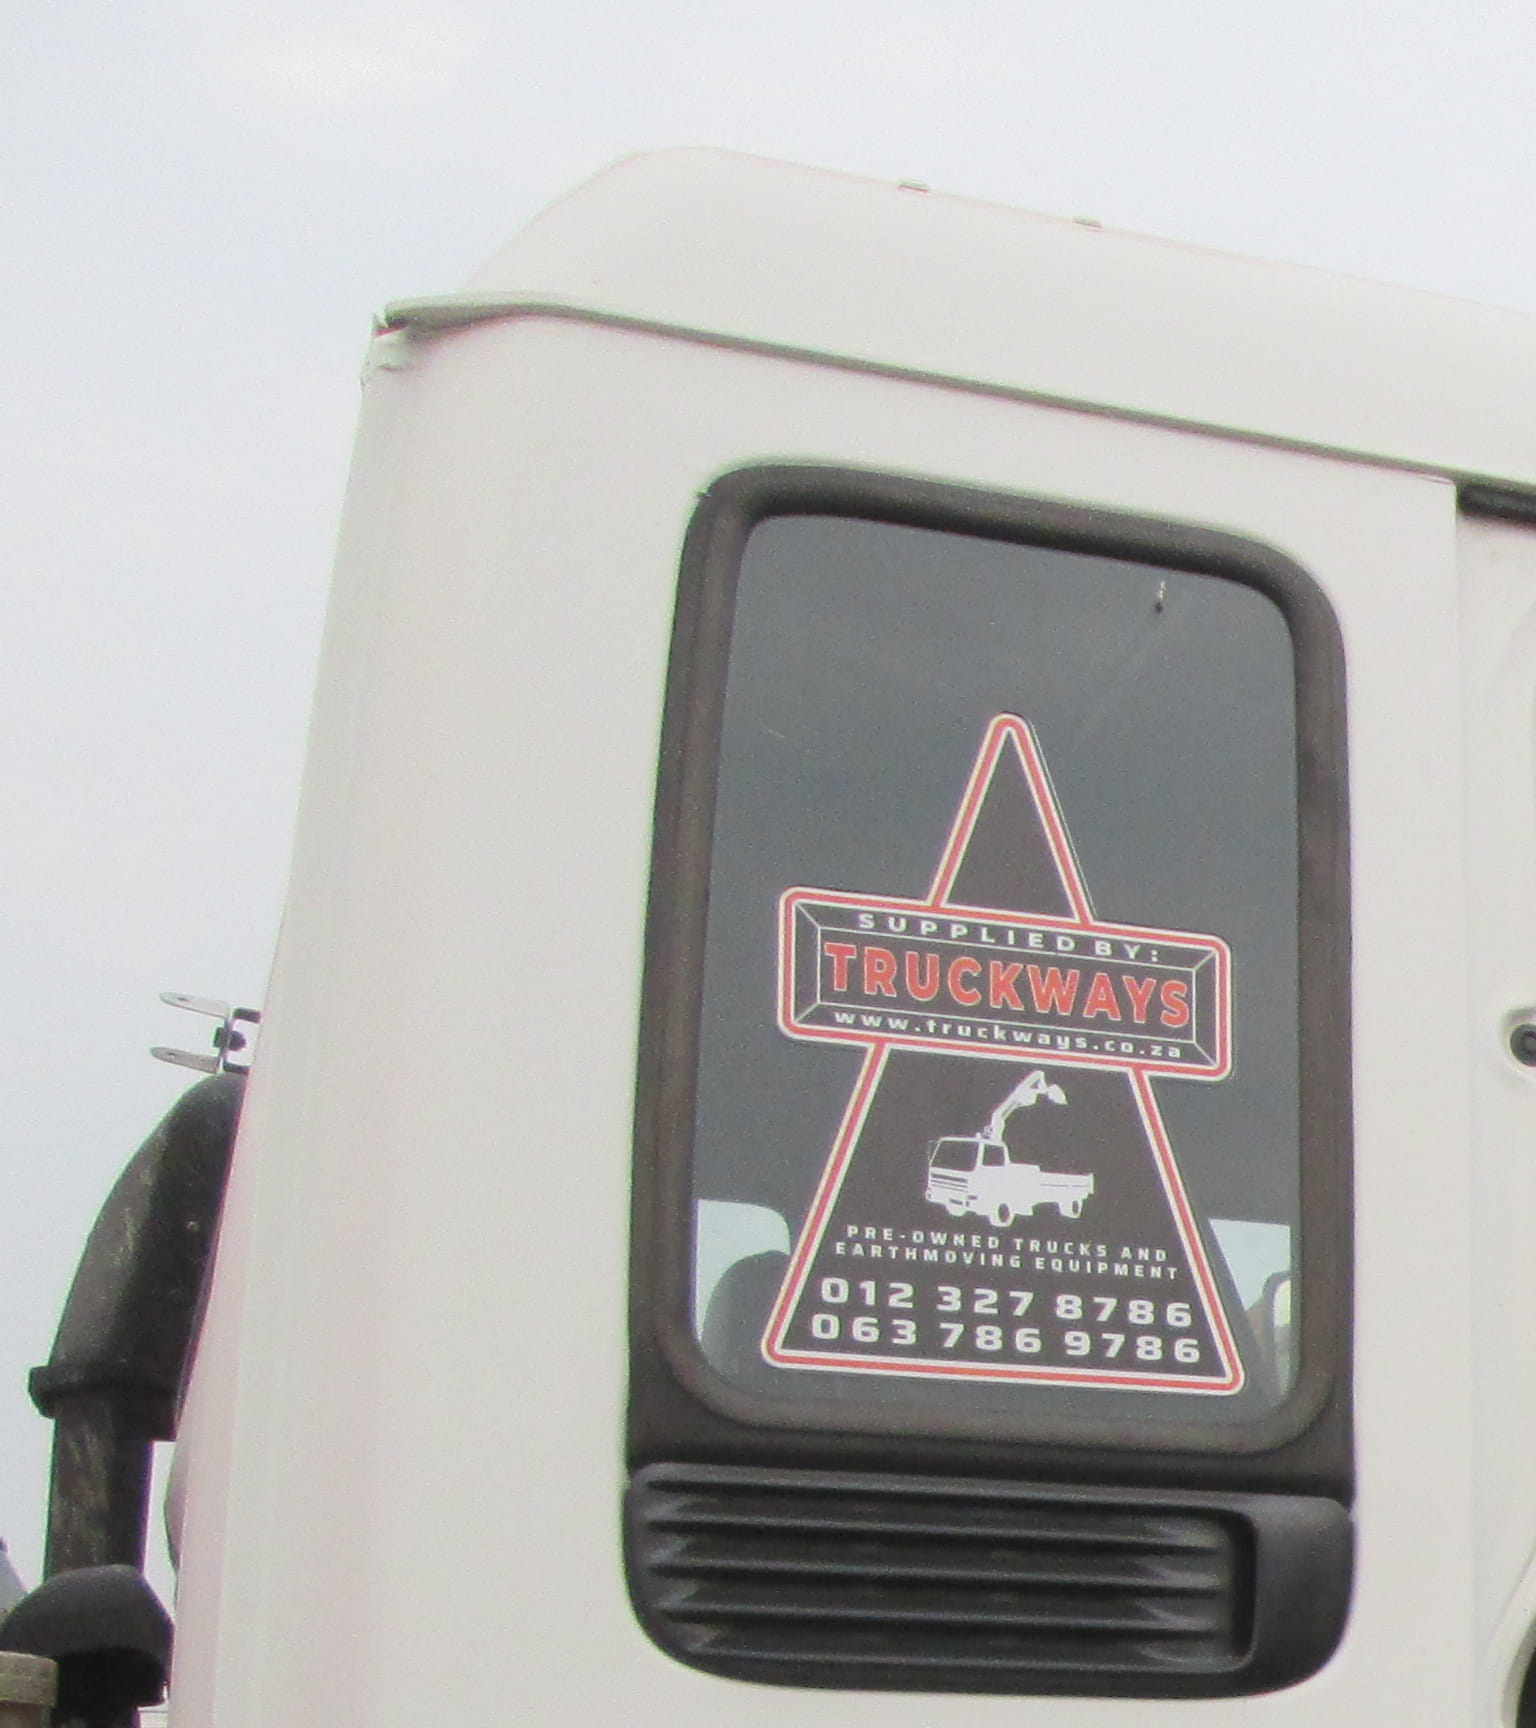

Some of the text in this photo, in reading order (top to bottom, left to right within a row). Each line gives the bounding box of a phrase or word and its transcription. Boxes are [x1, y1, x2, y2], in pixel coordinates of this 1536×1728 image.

[858, 912, 1160, 963] SUPPLIED BY:
[823, 941, 1190, 1028] TRUCKWAYS
[833, 1012, 1182, 1059] www.truckways.co.za
[835, 1241, 1179, 1281] EARTHMOVING EQUIPMENT
[847, 1225, 1169, 1262] PRE-OWNED TRUCKS AND
[820, 1276, 1193, 1328] 012 327 8786
[811, 1313, 1200, 1363] 063 786 9786
